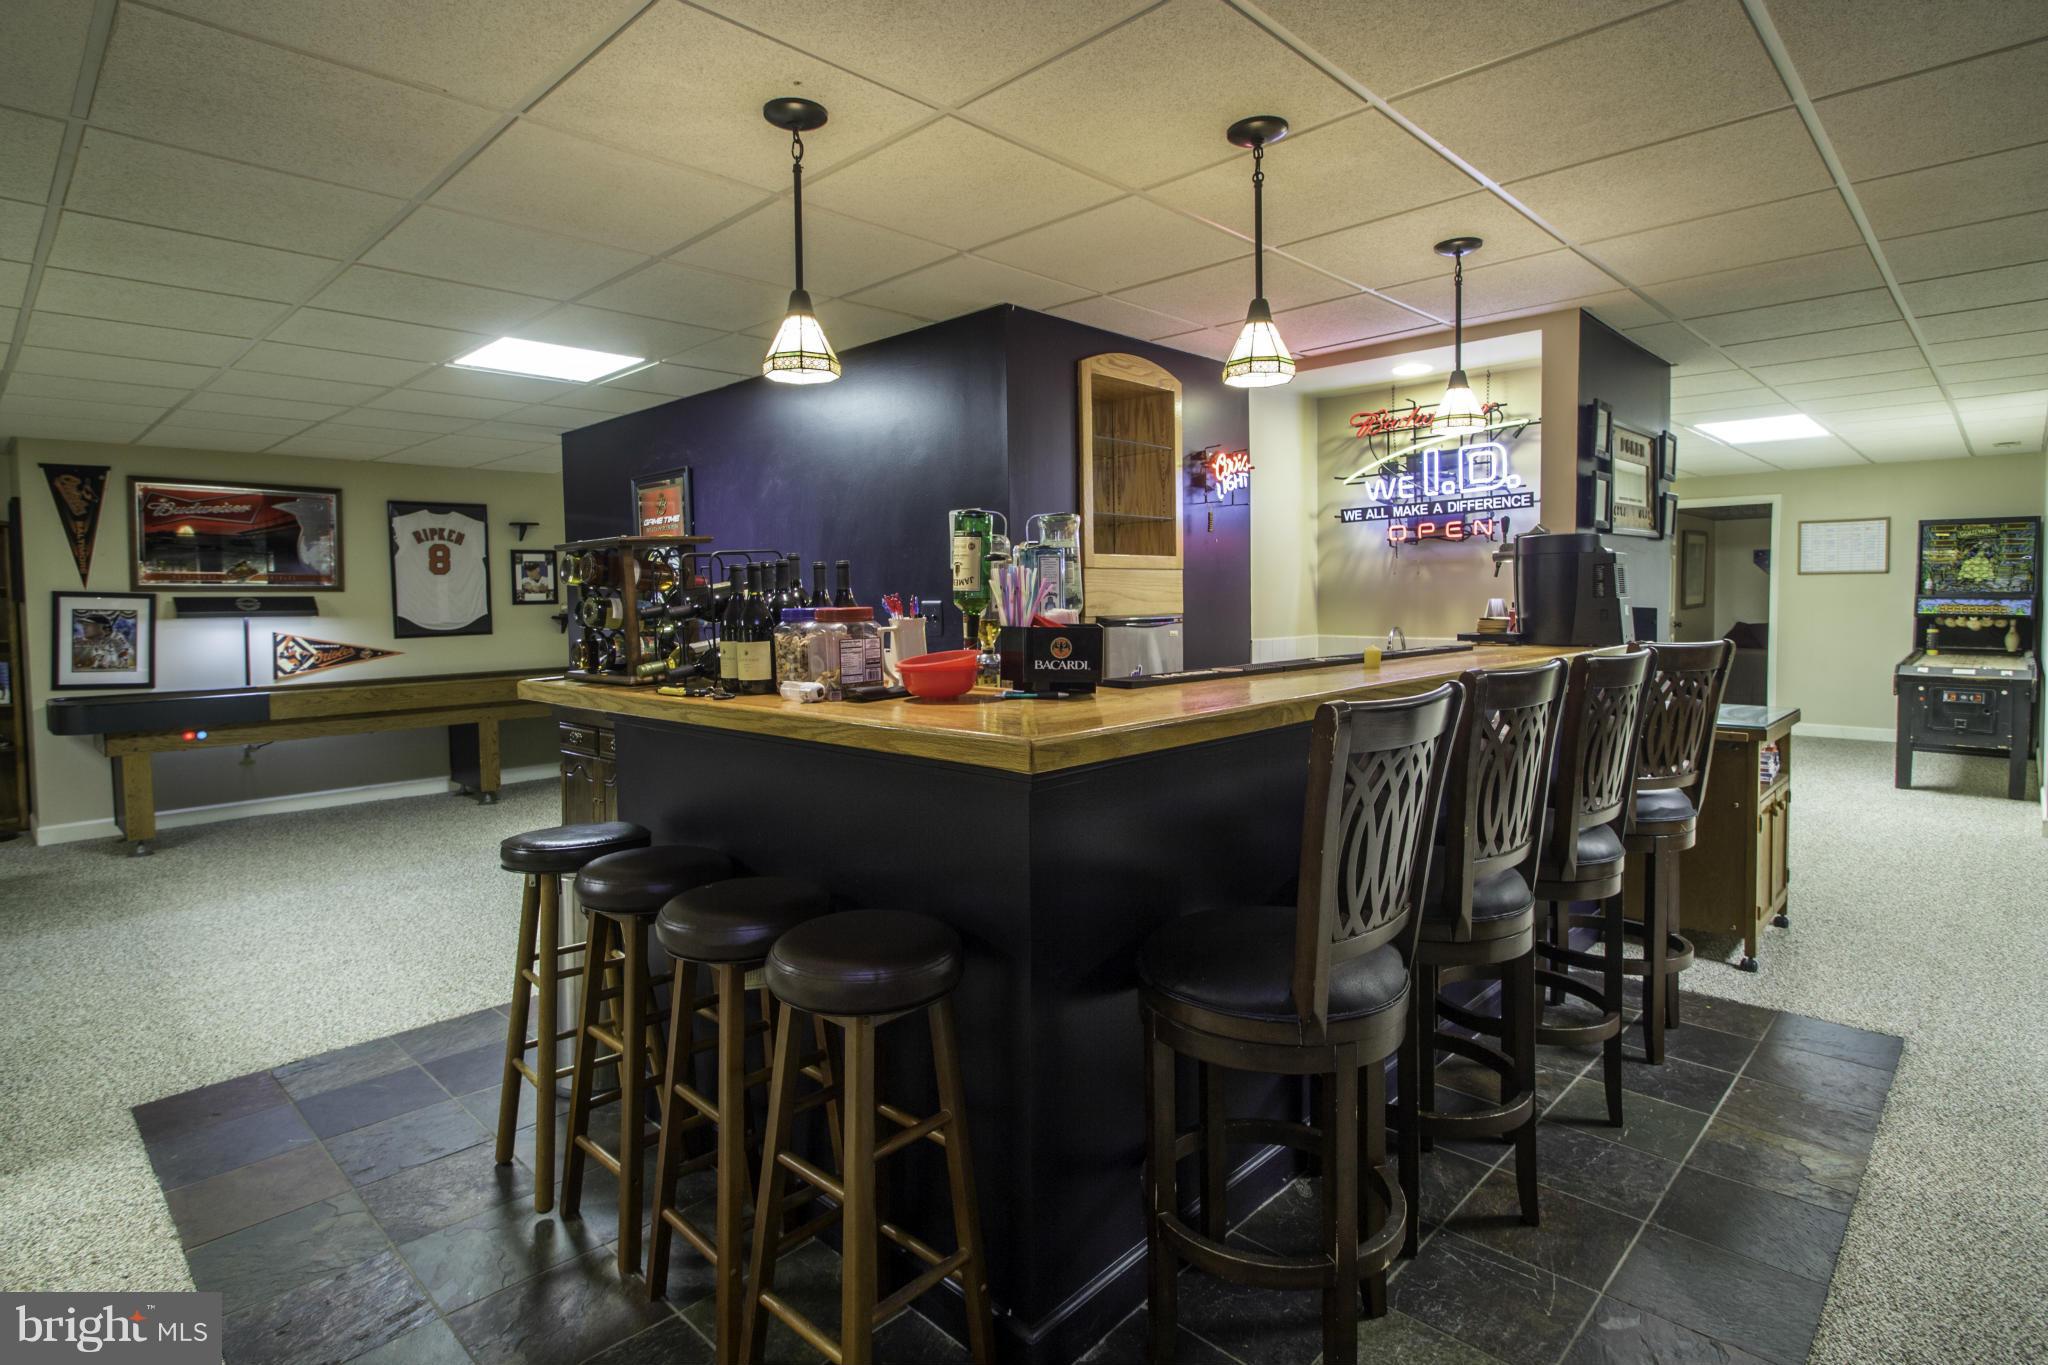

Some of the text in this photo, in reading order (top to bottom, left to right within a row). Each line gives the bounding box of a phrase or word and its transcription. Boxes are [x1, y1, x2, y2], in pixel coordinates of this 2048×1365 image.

[1215, 472, 1249, 500] LIGHT
[1365, 476, 1414, 501] WE
[147, 501, 252, 517] Budweiser
[1343, 494, 1532, 522] WE ALL MAKE A DIFFERENCE
[411, 527, 466, 546] RIPKEN
[1388, 518, 1493, 541] OPEN
[428, 543, 452, 576] 8
[953, 576, 975, 587] JAME
[1034, 659, 1088, 671] BACARDI
